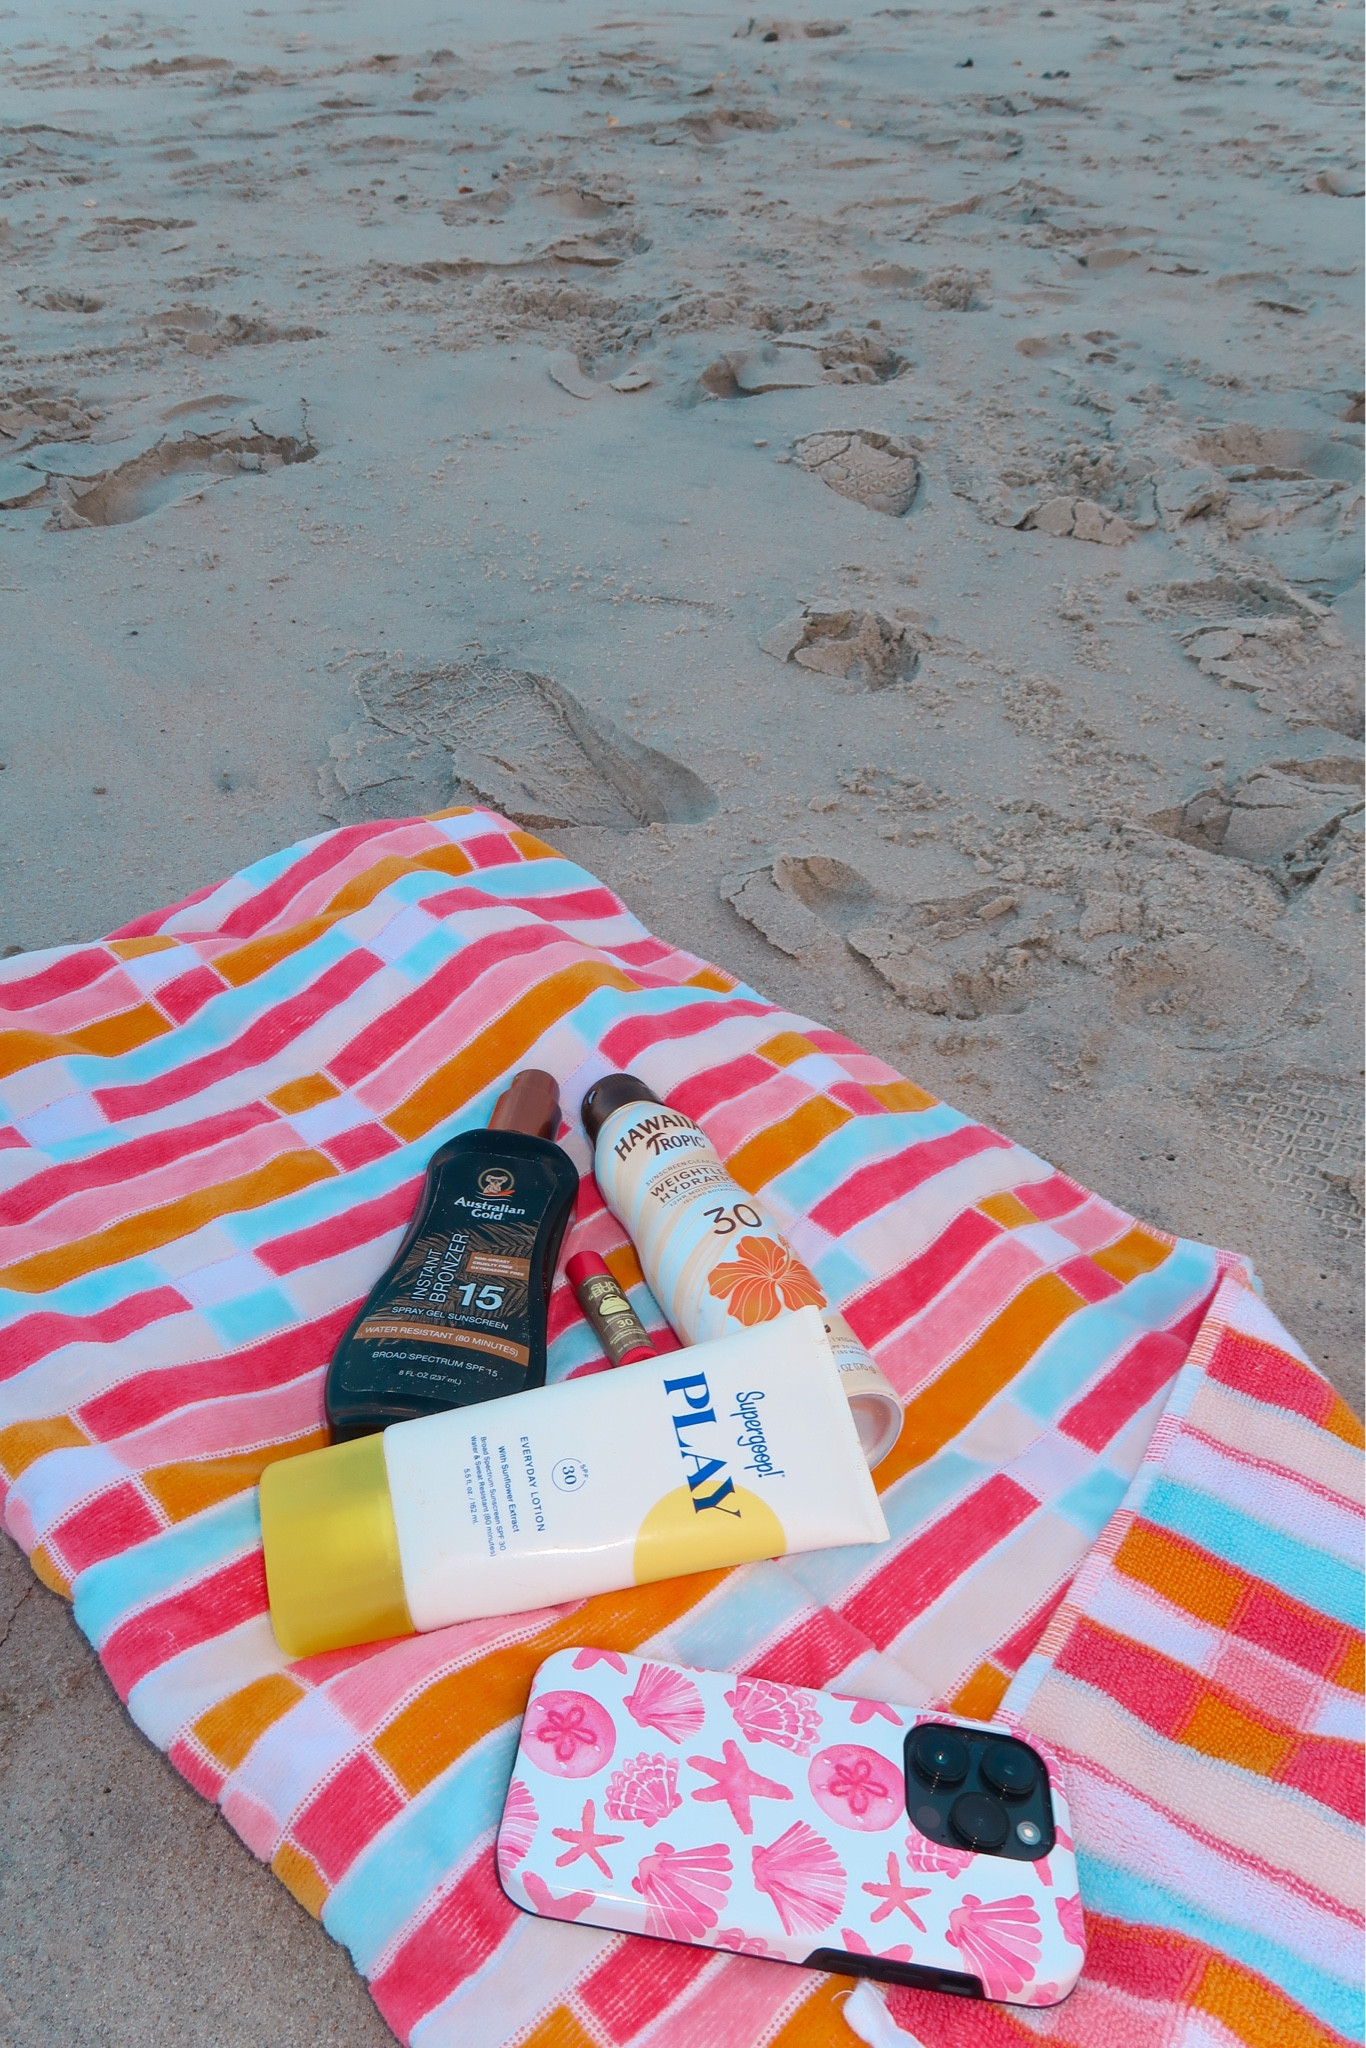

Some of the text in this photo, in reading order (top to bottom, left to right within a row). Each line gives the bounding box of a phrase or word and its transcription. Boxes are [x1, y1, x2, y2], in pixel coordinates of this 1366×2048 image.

[614, 1114, 705, 1162] HAWAIIA
[646, 1132, 706, 1156] TROPIC
[646, 1161, 687, 1187] SUNSCREEN
[454, 1196, 526, 1215] Australian
[471, 1209, 503, 1221] Gold
[703, 1203, 762, 1235] 30
[411, 1248, 443, 1300] INSTANT
[429, 1233, 470, 1303] BRONZER
[457, 1282, 505, 1311] 15
[391, 1306, 509, 1331] SPRAY GEL SUNSCREEN
[616, 1318, 635, 1328] 30
[365, 1326, 519, 1358] WATER RESISTANT (80 MINUTES)
[371, 1350, 499, 1378] BROAD SPECTRUM SPF 15
[416, 1371, 429, 1379] OZ
[429, 1373, 446, 1382] (237
[470, 1434, 478, 1454] Water
[663, 1370, 742, 1519] PLAY
[729, 1390, 785, 1479] Supergoop!
[474, 1460, 484, 1481] Sweat
[520, 1435, 546, 1532] EVERYDAY LOTION
[562, 1465, 577, 1485] 30
[580, 1463, 589, 1479] SPF
[463, 1468, 472, 1479] 5.5
[469, 1501, 478, 1514] 162
[478, 1481, 489, 1513] Resistant
[480, 1436, 507, 1551] Broad Spectrum Sunscreen SPF 30
[498, 1445, 519, 1533] With Sunflower Extract
[482, 1513, 492, 1525] (80
[485, 1526, 497, 1557] minutes)
